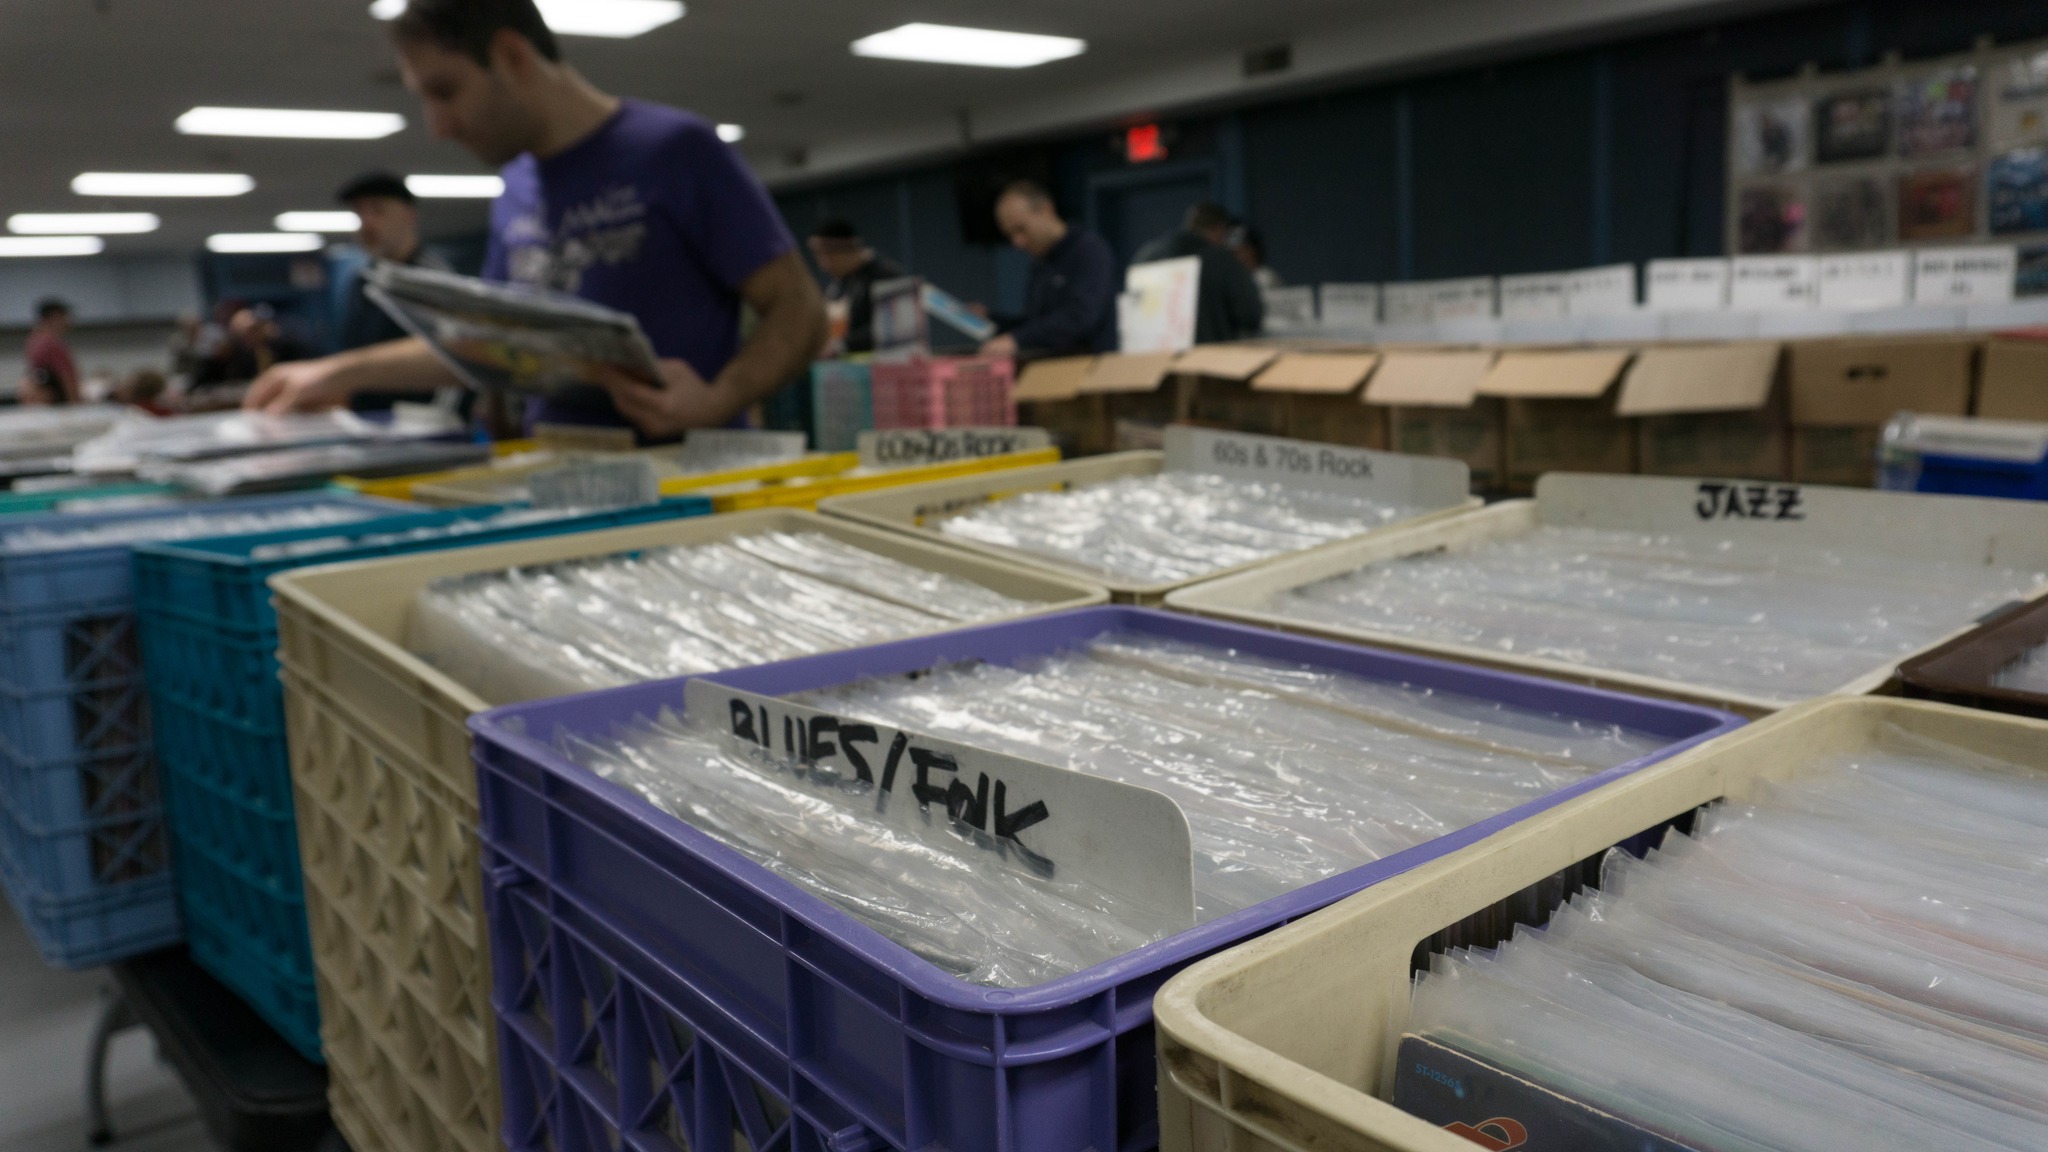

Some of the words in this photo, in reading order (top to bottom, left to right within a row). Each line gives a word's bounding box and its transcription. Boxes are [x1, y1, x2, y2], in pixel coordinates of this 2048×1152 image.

[1213, 440, 1249, 466] 60s
[1254, 445, 1269, 467] &
[1275, 447, 1312, 473] 70s
[1318, 451, 1374, 479] Rock
[1696, 483, 1806, 520] JAZZ
